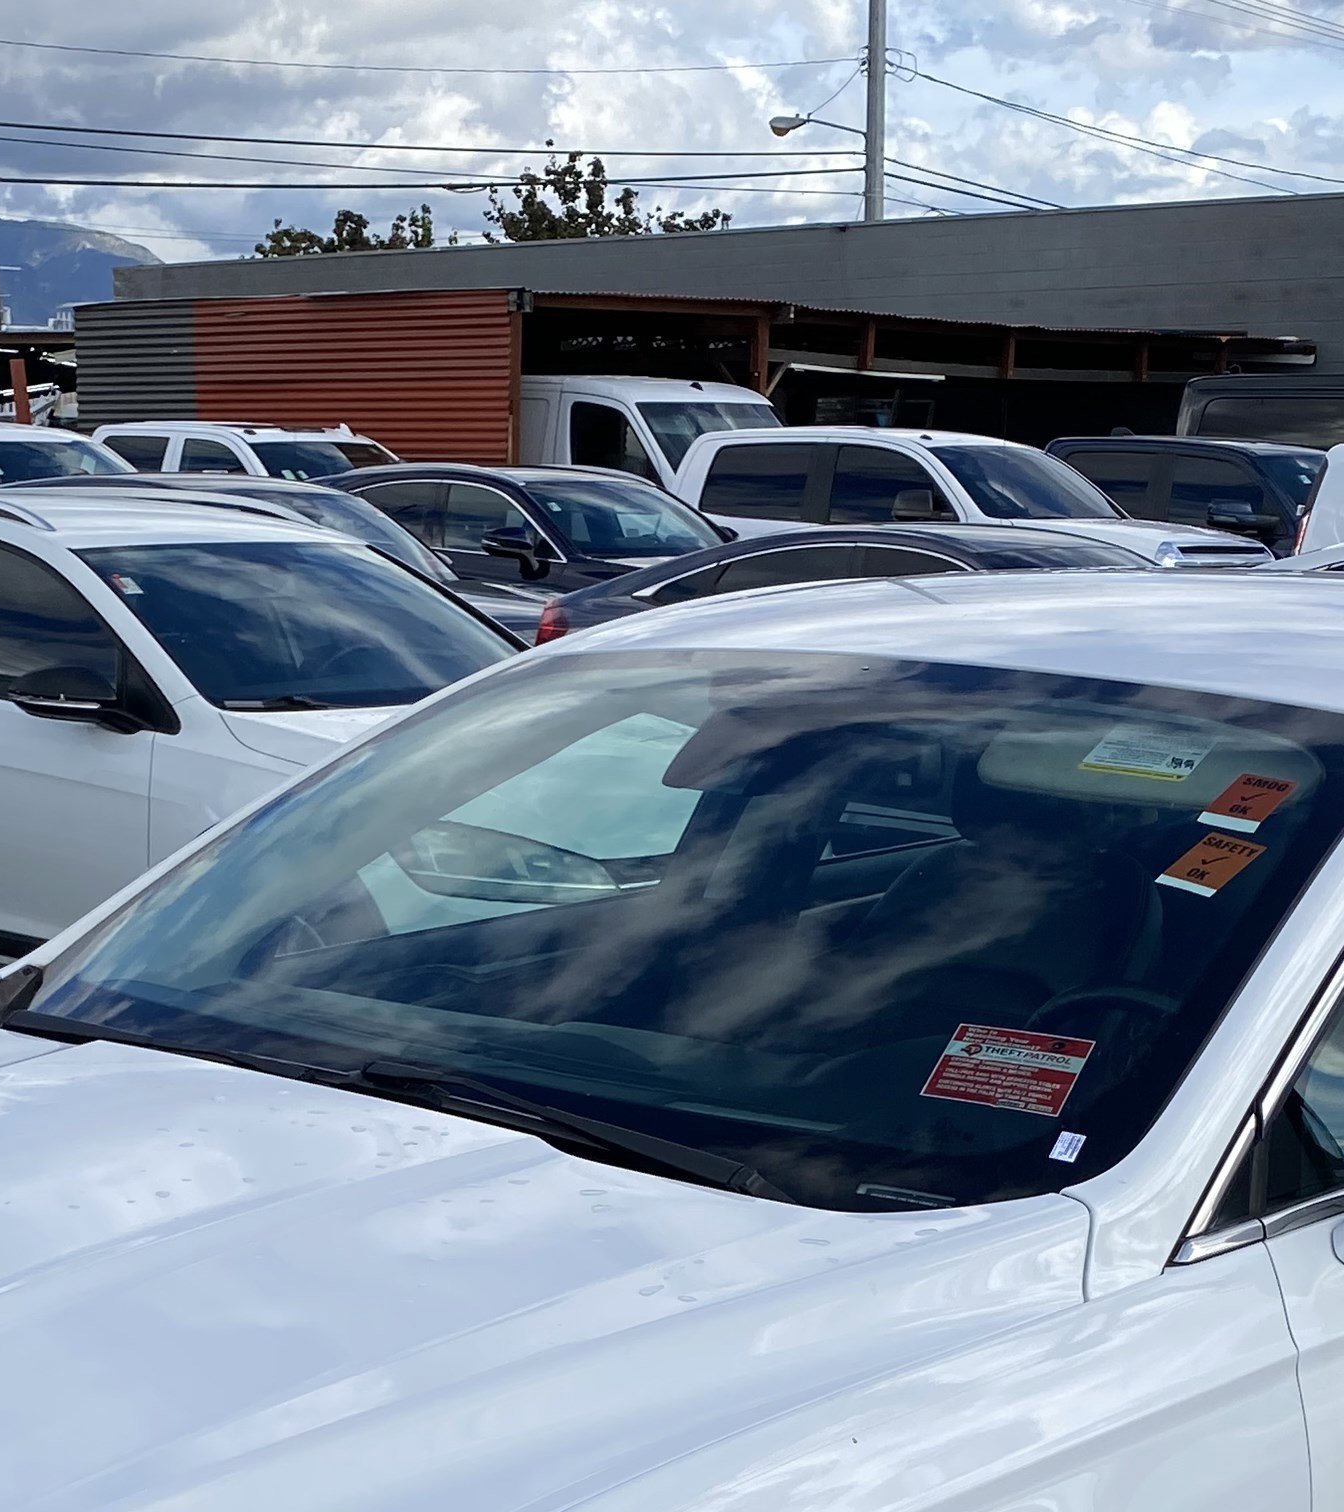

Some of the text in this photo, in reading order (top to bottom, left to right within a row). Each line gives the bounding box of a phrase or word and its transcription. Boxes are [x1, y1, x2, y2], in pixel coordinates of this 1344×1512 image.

[1229, 803, 1252, 815] OK
[1202, 836, 1258, 857] SAFETY
[1186, 867, 1211, 881] OK
